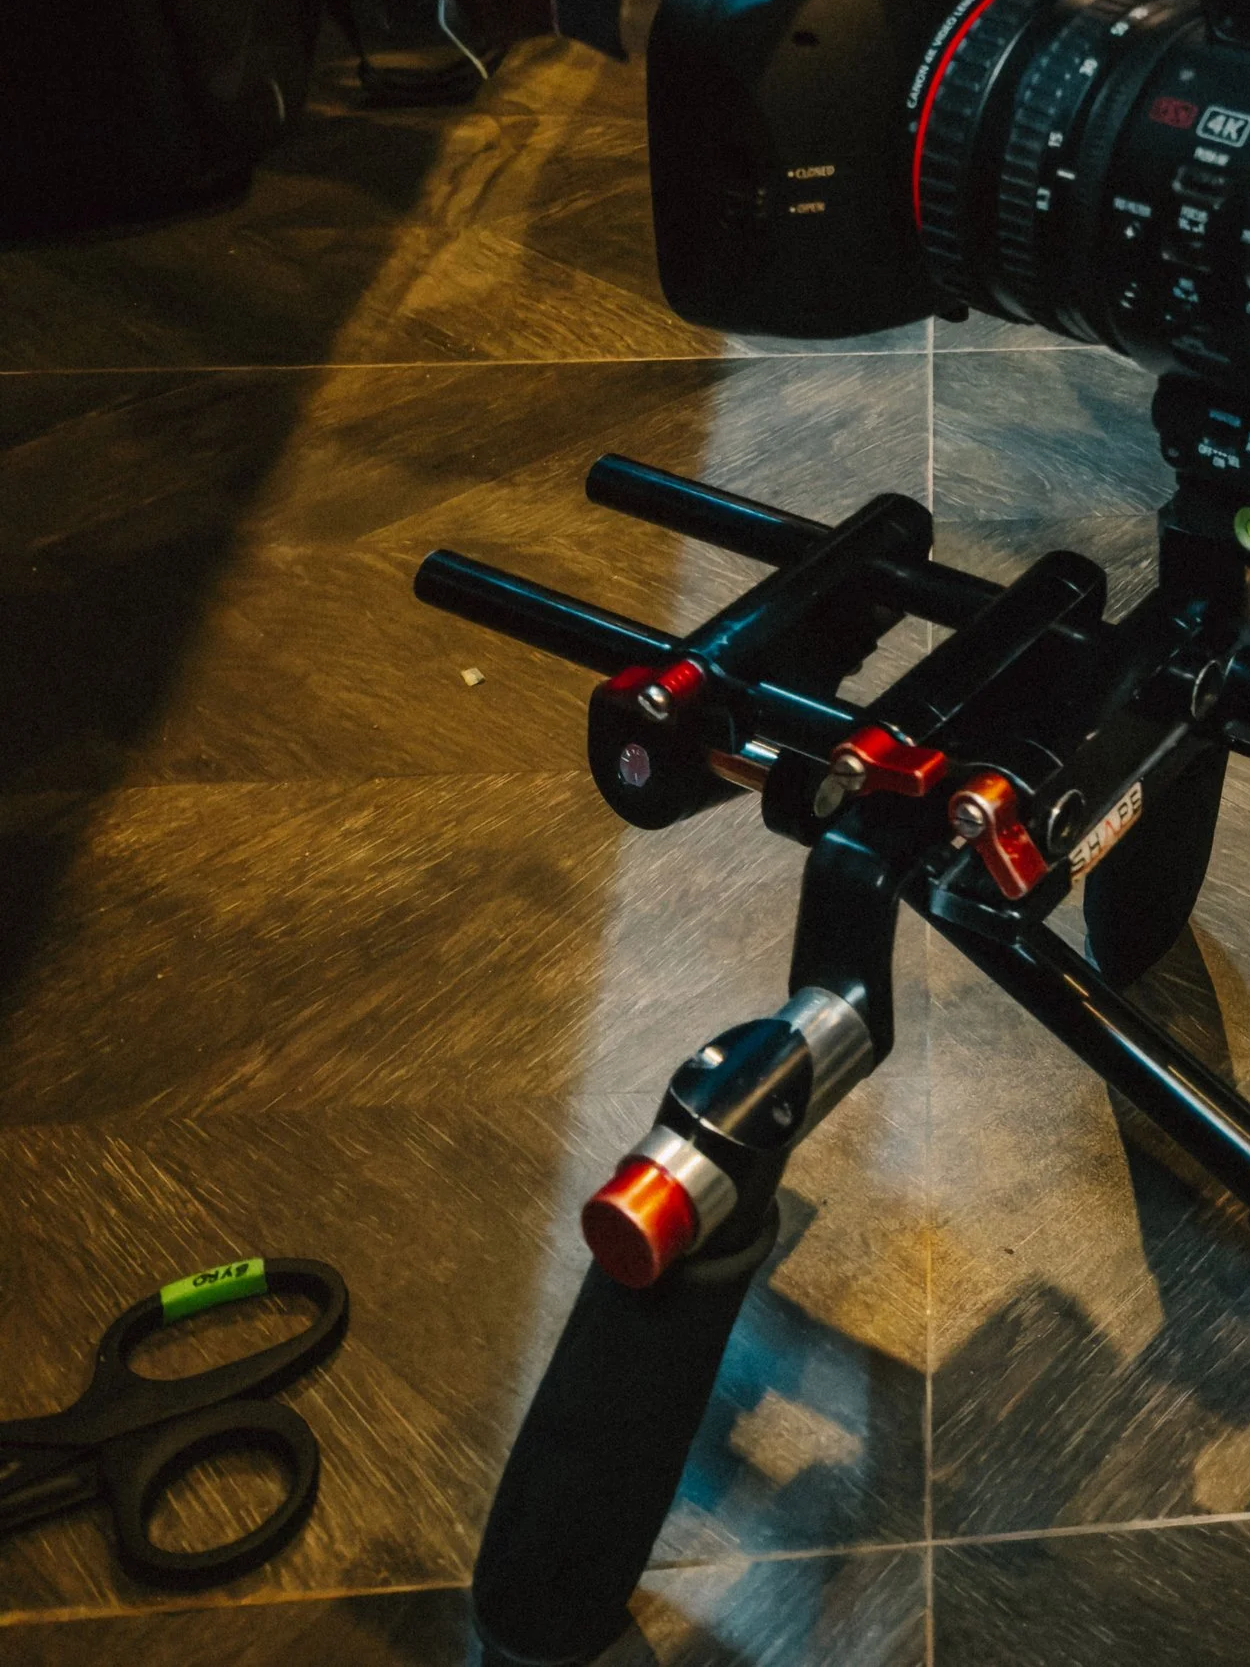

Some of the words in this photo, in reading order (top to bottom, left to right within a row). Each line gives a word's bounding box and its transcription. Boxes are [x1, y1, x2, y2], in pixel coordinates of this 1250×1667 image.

[907, 64, 929, 108] CANON
[932, 17, 957, 47] VIDEO
[1205, 113, 1247, 143] 4K
[795, 164, 836, 180] CLOSED
[1069, 789, 1143, 877] SHAPE
